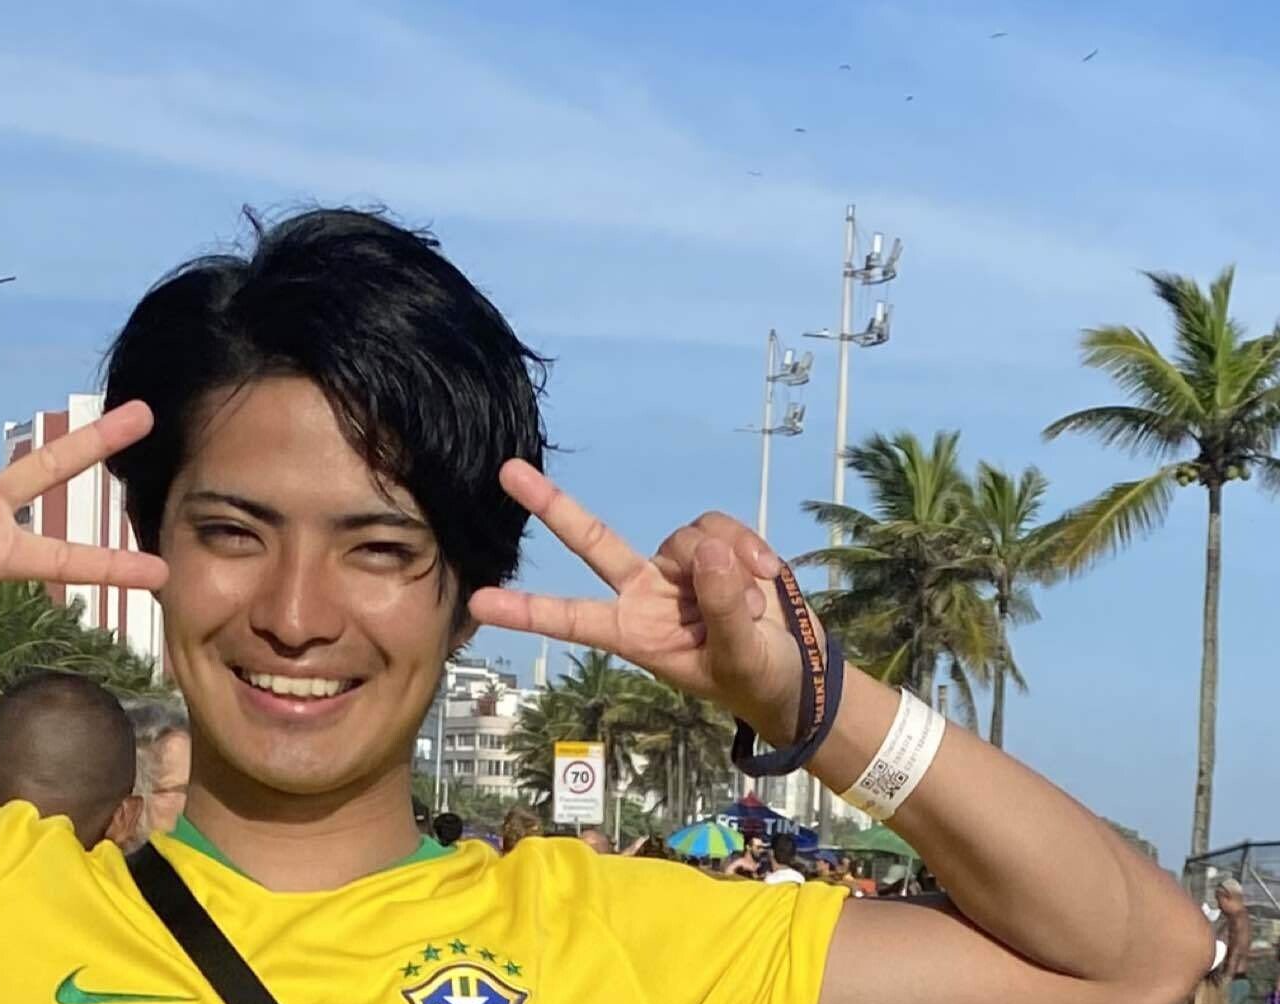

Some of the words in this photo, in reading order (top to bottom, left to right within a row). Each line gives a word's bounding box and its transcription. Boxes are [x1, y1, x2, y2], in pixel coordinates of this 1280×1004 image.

[800, 618, 817, 645] DEN
[809, 649, 824, 673] MIT
[814, 675, 825, 725] MARKE
[571, 771, 590, 784] 70
[763, 818, 800, 835] TIM
